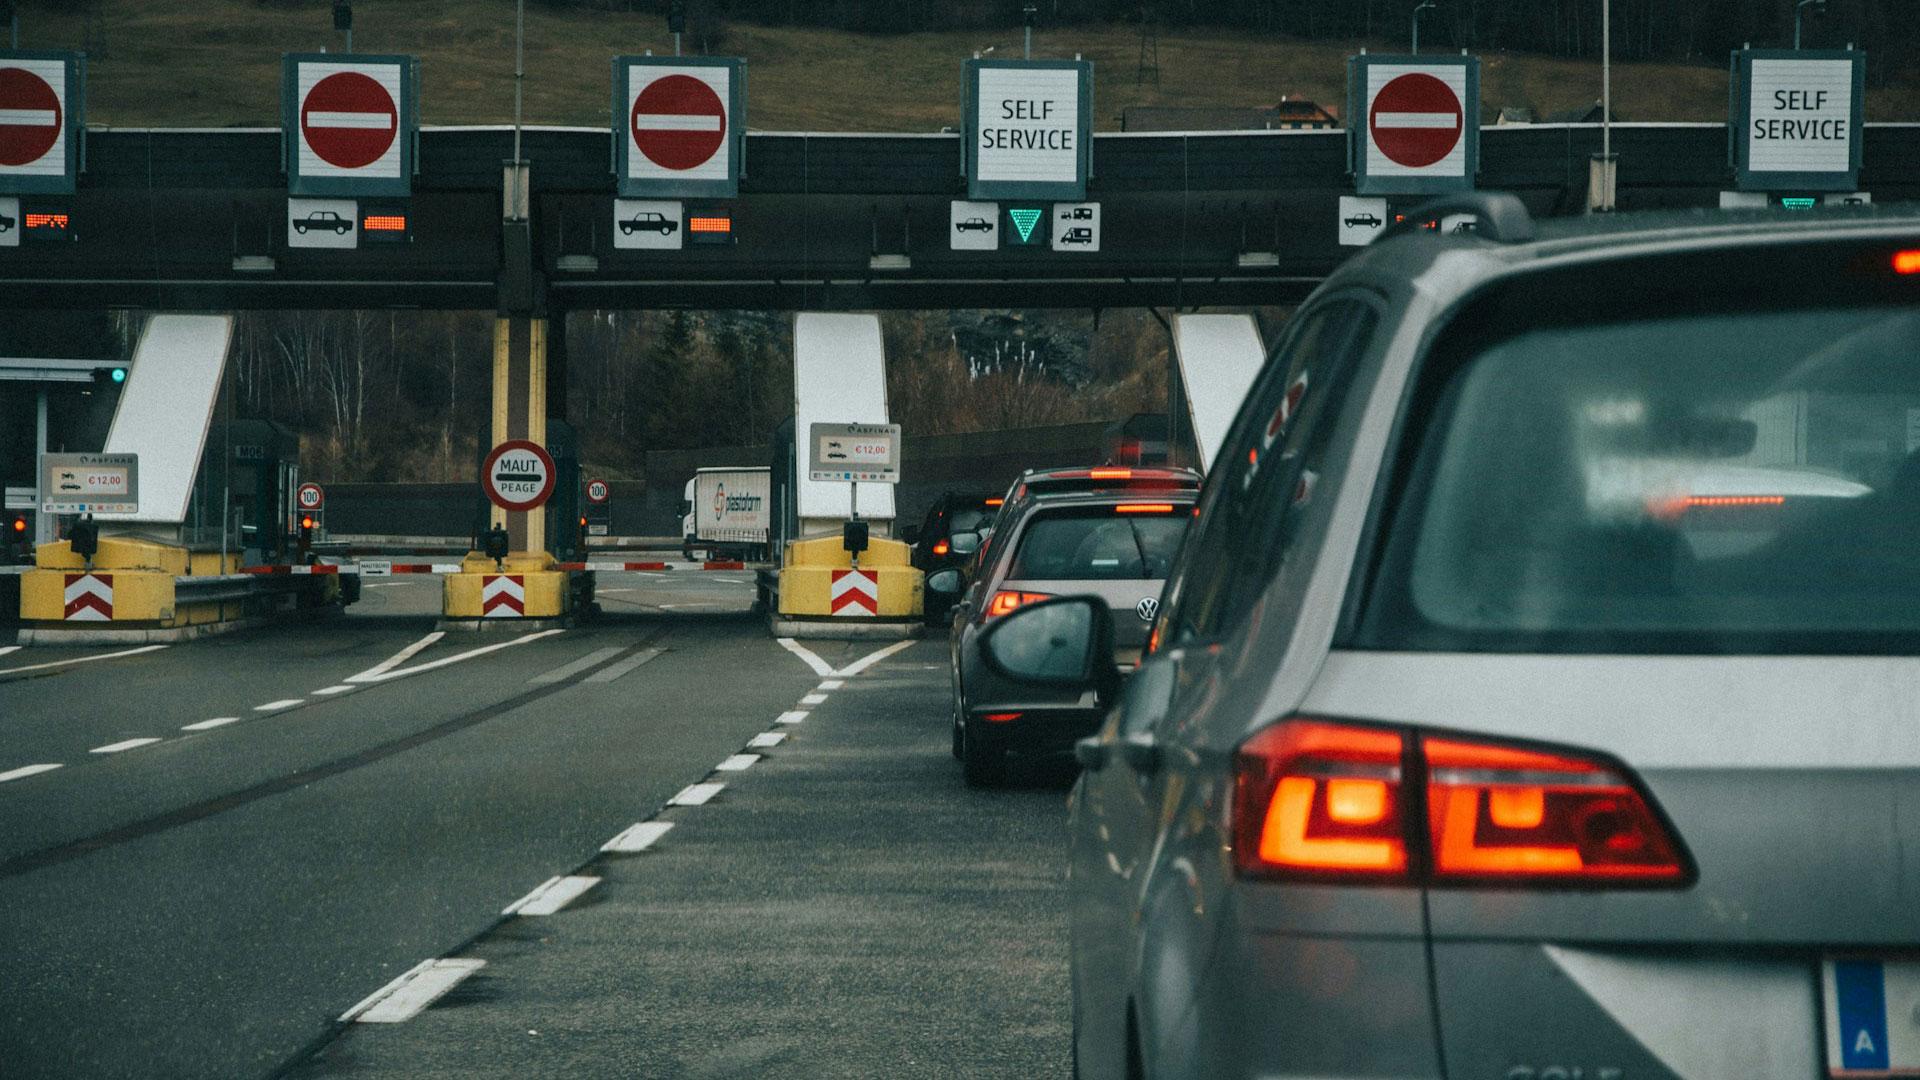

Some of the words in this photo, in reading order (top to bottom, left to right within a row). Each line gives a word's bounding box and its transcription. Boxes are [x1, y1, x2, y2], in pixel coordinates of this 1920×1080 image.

[1774, 90, 1828, 110] SELF
[1002, 99, 1054, 119] SELF
[1754, 119, 1846, 140] SERVICE
[982, 128, 1073, 150] SERVICE
[865, 446, 885, 455] 12,00
[500, 459, 538, 472] MAUT
[98, 476, 121, 486] 12,00
[501, 482, 536, 493] PEAGE
[303, 491, 317, 503] 100
[592, 486, 605, 496] 100
[1855, 1029, 1874, 1053] A
